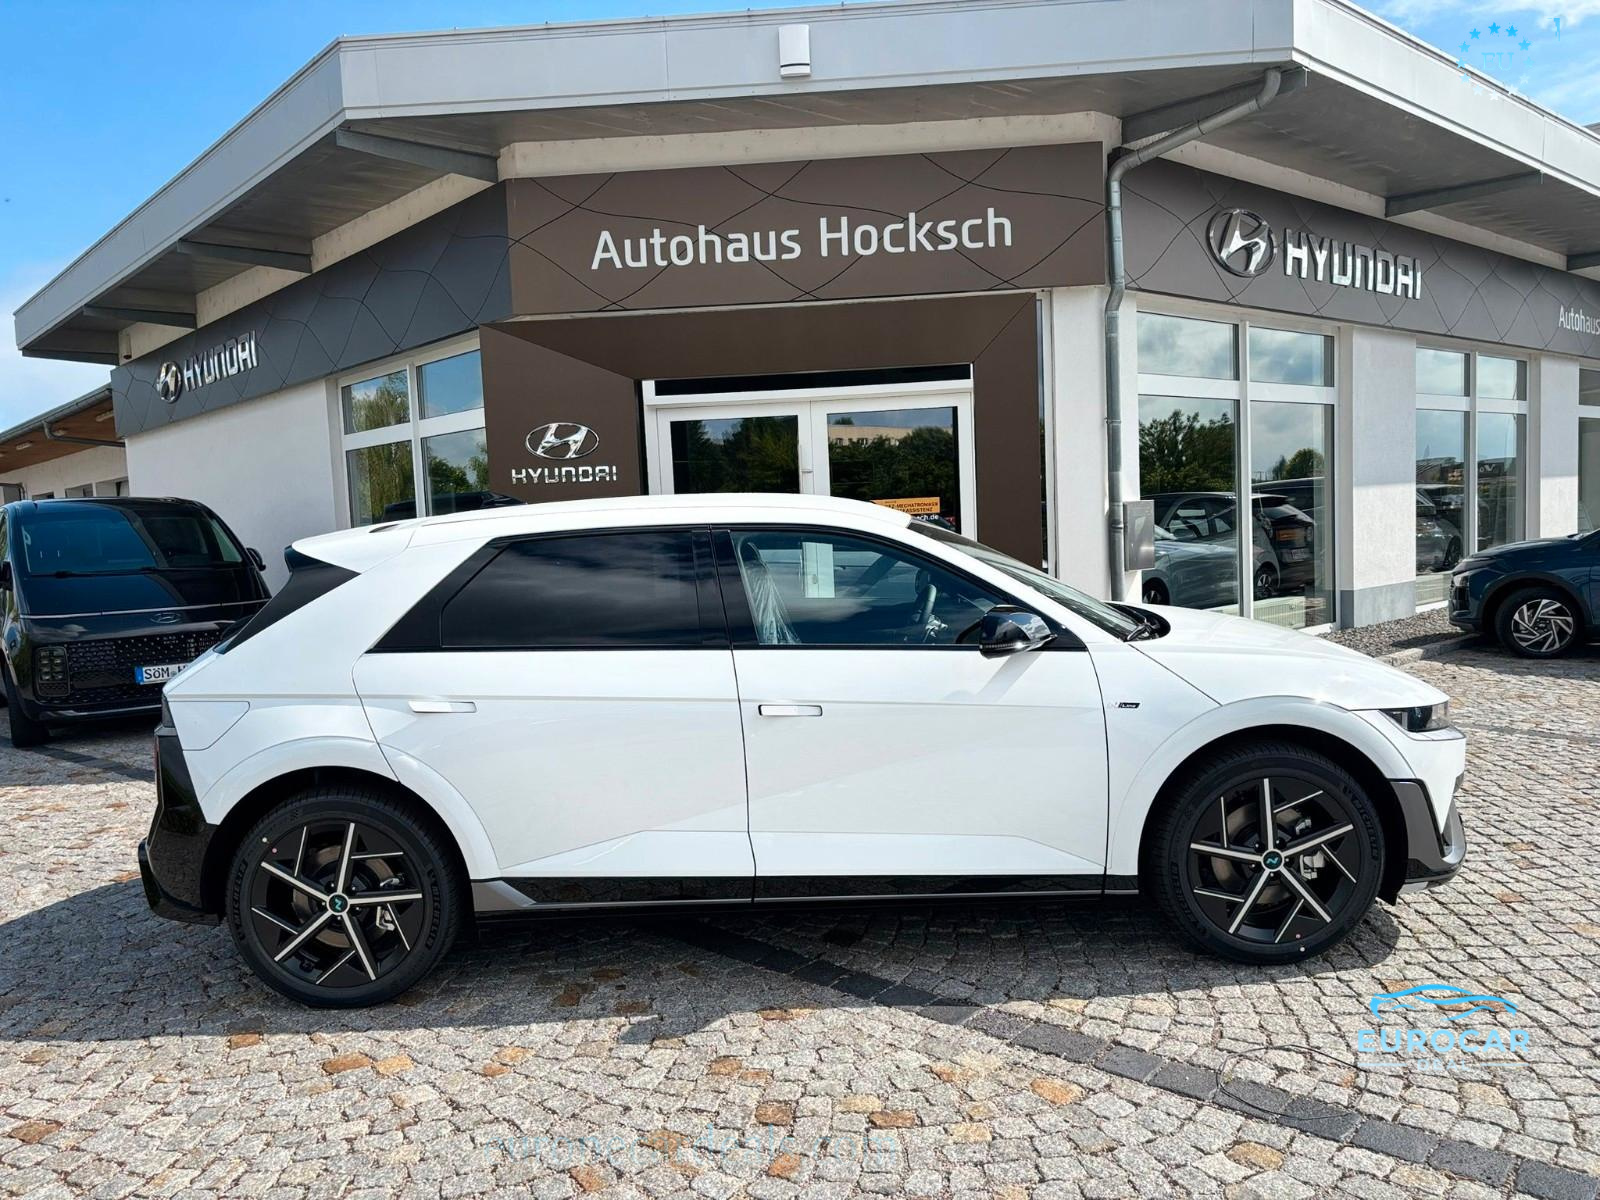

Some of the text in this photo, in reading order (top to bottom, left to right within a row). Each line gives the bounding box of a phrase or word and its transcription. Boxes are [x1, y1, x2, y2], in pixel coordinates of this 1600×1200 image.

[591, 207, 1013, 270] Autohaus Hocksch
[1284, 228, 1422, 300] HYUNDAI
[1558, 304, 1600, 336] Autohaus
[183, 329, 259, 392] HYUNDAI
[511, 465, 617, 484] HYUNDAI
